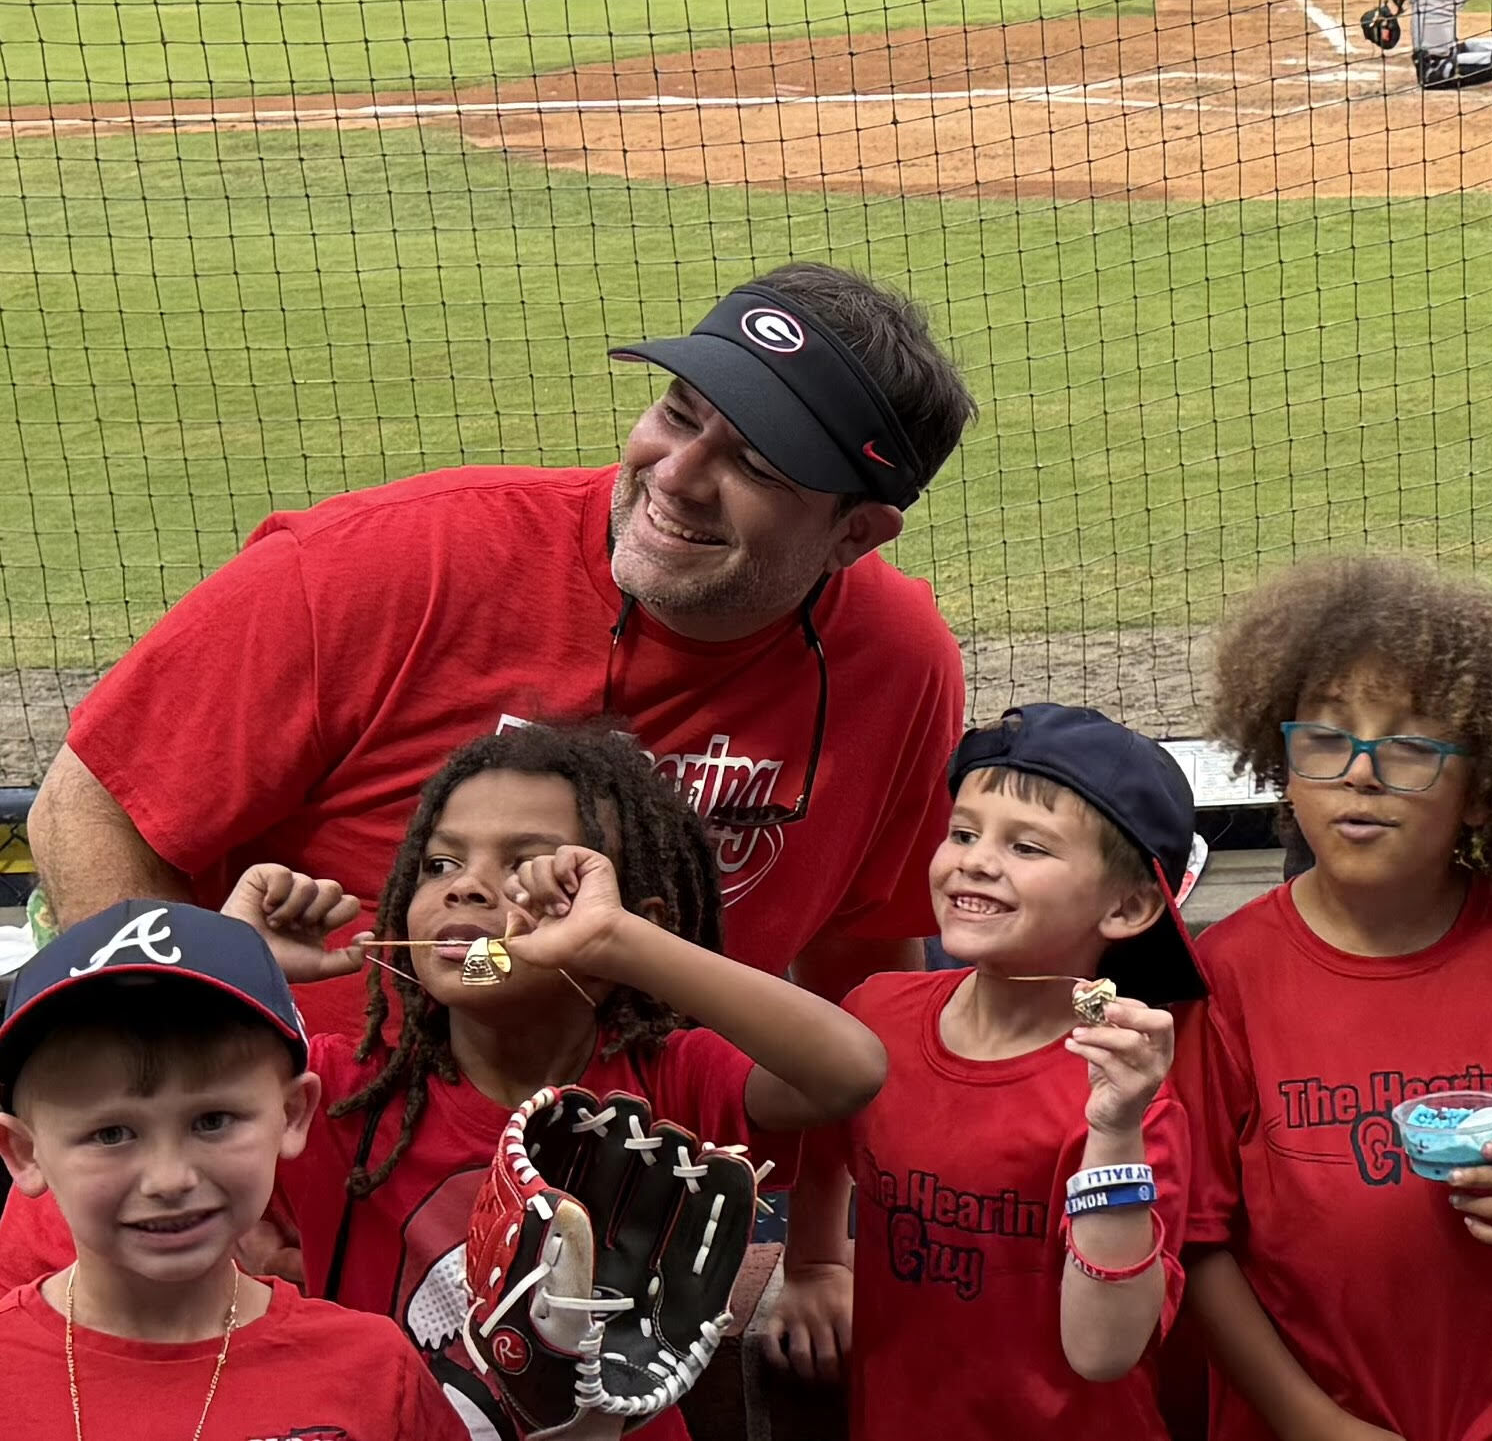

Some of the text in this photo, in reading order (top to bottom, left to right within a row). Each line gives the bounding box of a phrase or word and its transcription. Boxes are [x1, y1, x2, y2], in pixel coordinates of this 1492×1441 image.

[746, 311, 804, 349] G
[70, 908, 182, 977] A
[1278, 1077, 1359, 1129] The
[908, 1170, 1048, 1240] Hearin
[1087, 1167, 1134, 1185] BALL!
[887, 1205, 985, 1302] Guy
